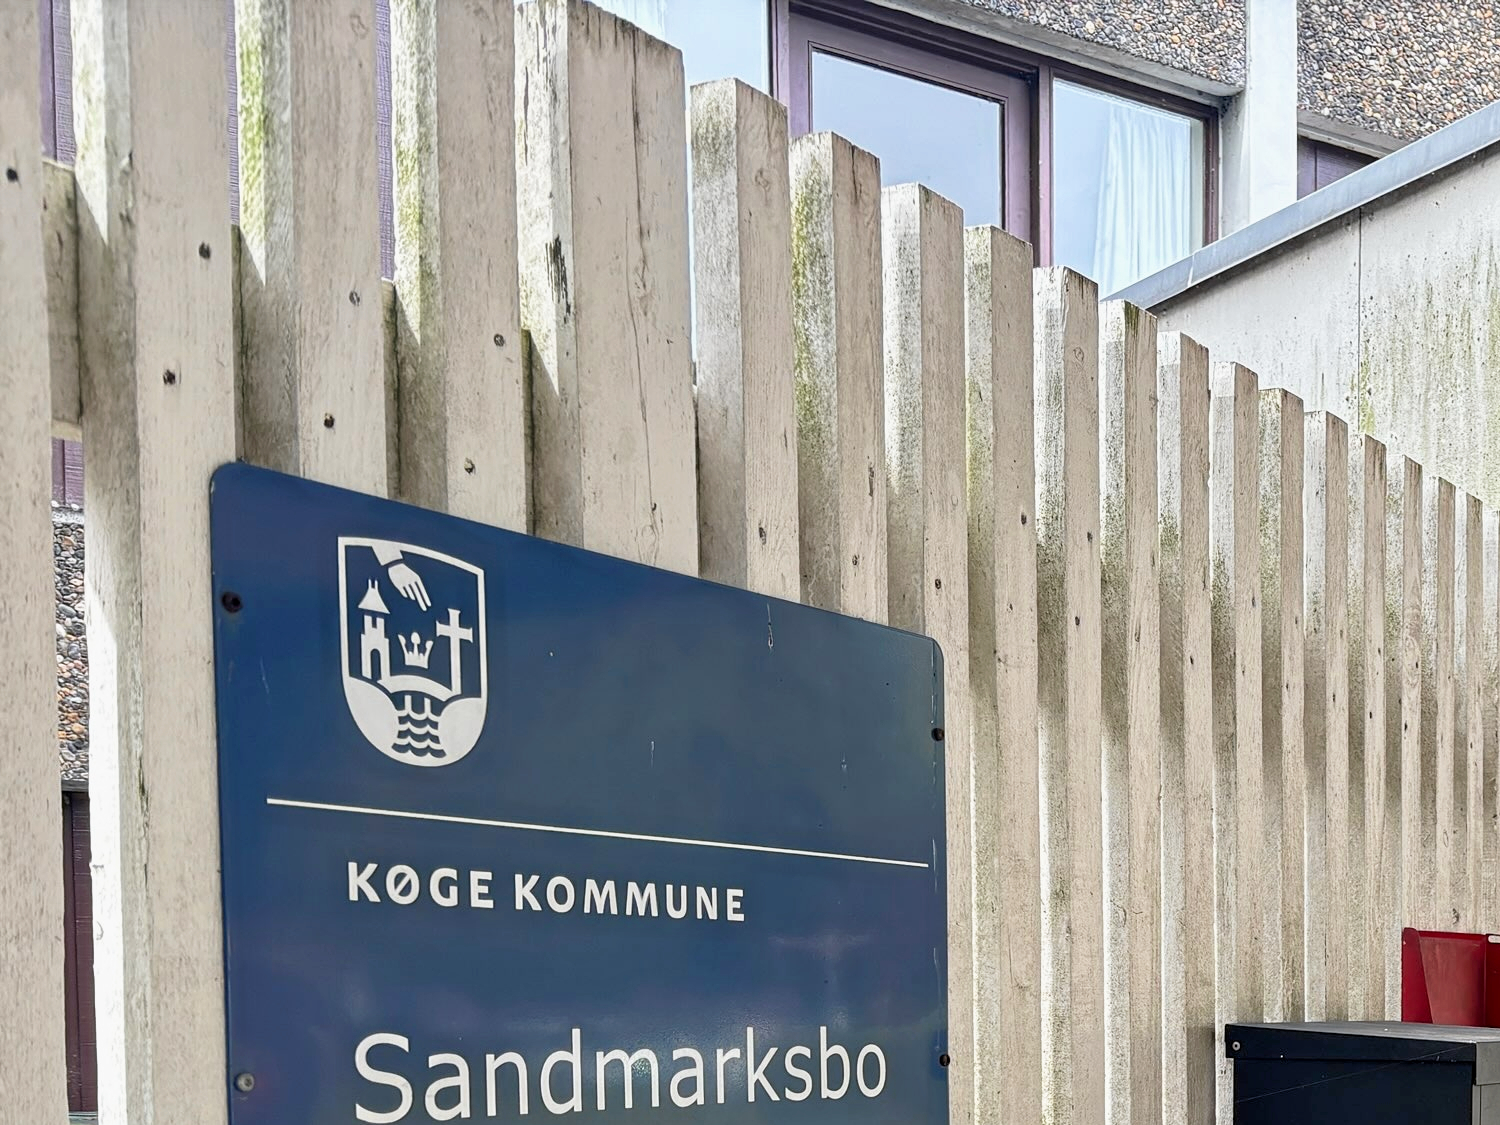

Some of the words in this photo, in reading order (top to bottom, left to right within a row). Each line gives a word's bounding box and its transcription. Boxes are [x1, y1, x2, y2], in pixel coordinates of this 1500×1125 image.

[346, 860, 495, 910] KØGE
[514, 872, 747, 923] KOMMUNE
[353, 1025, 888, 1125] Sandmarksbo
